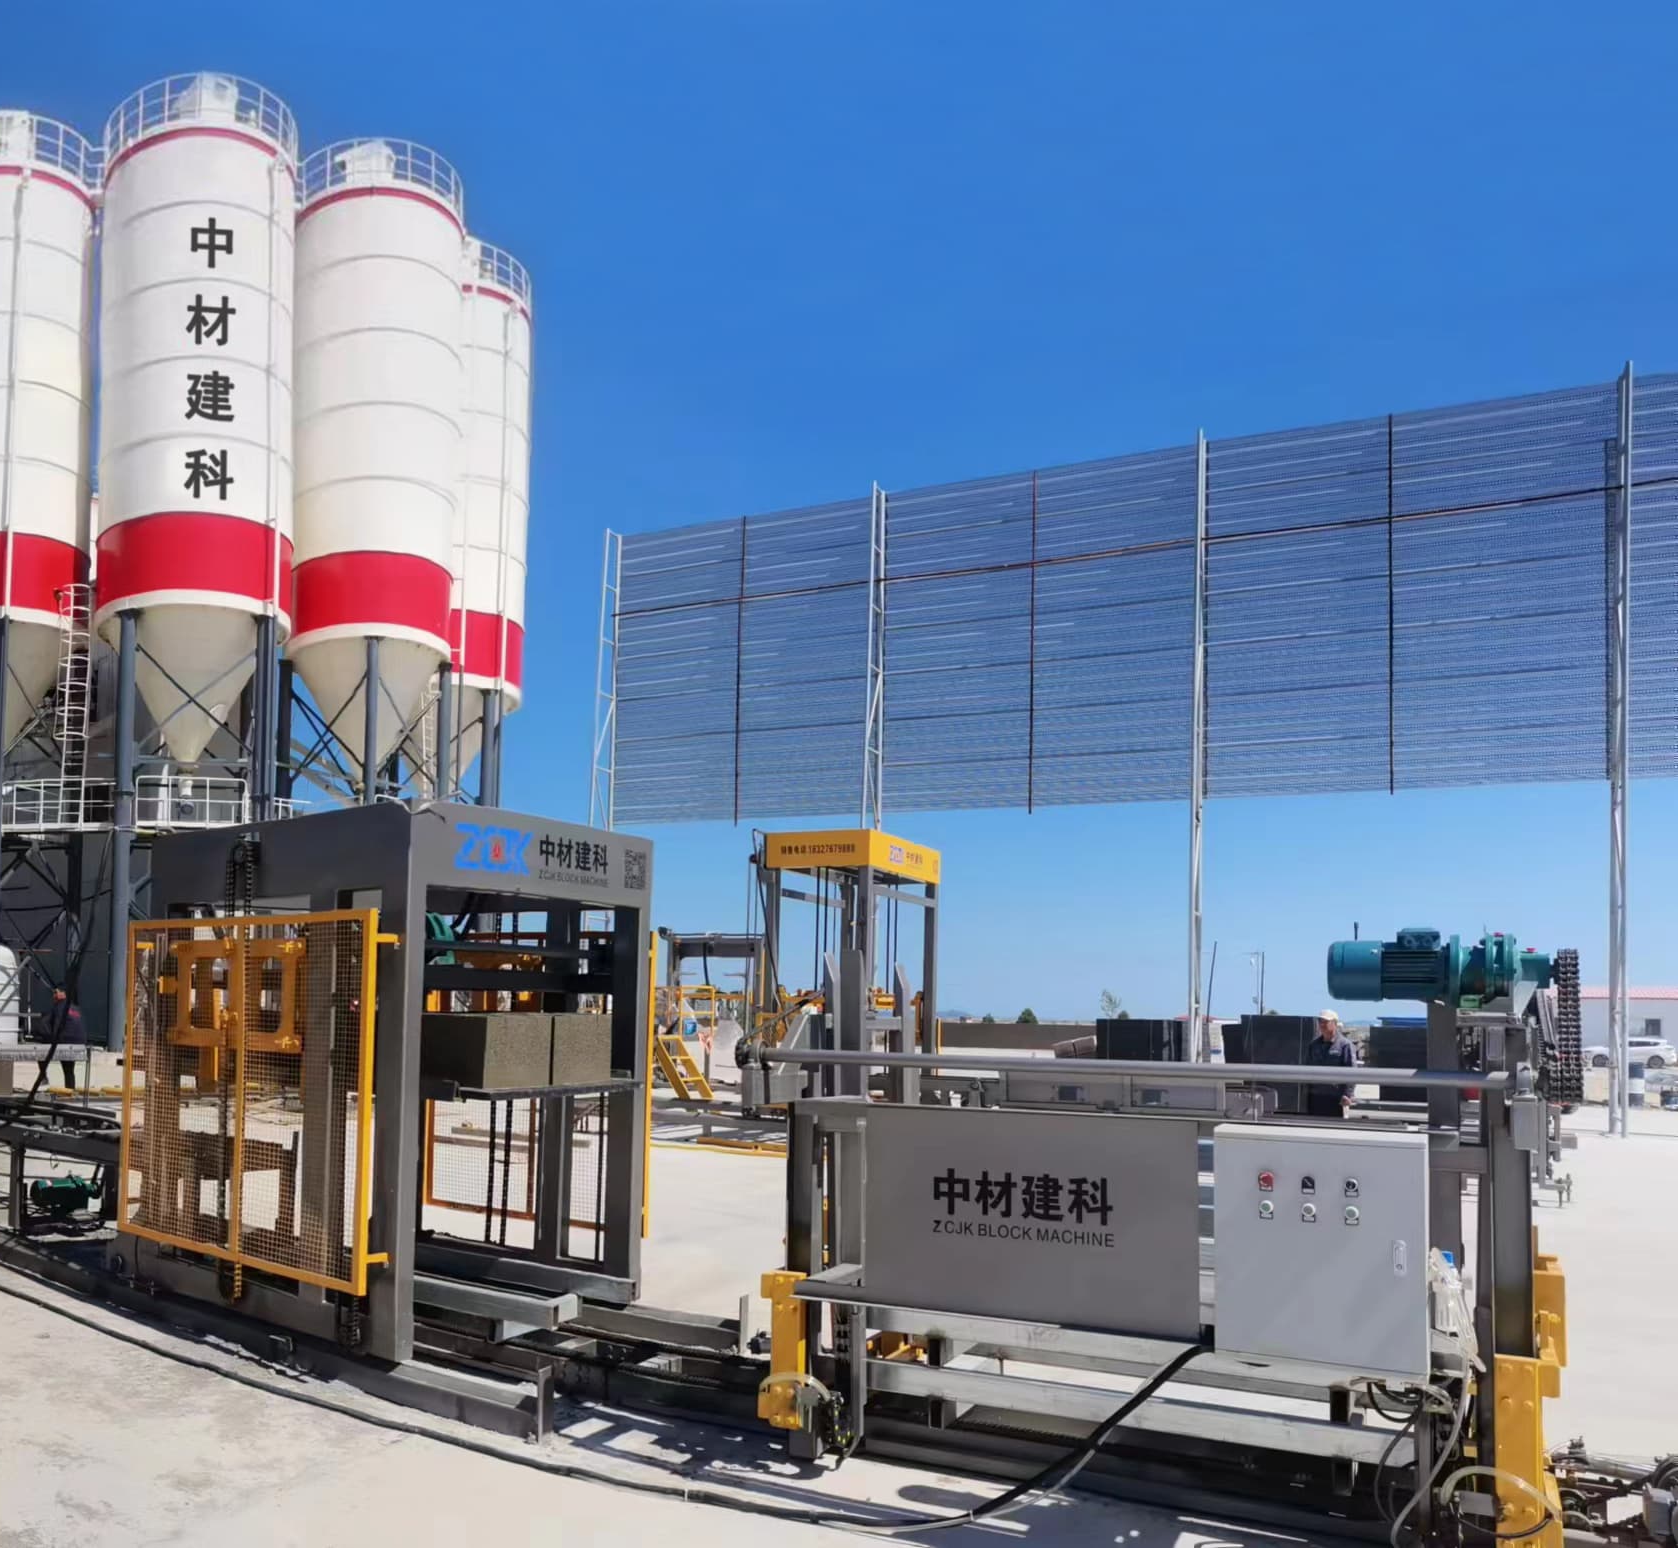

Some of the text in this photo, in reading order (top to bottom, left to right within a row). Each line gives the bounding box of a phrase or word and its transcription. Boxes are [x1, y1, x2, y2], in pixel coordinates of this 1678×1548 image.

[184, 217, 236, 501] 中材建科
[539, 834, 609, 875] 中材建科
[933, 1167, 1113, 1226] 中材建科
[932, 1219, 1115, 1248] ZCJK BLOCK MACHINE
